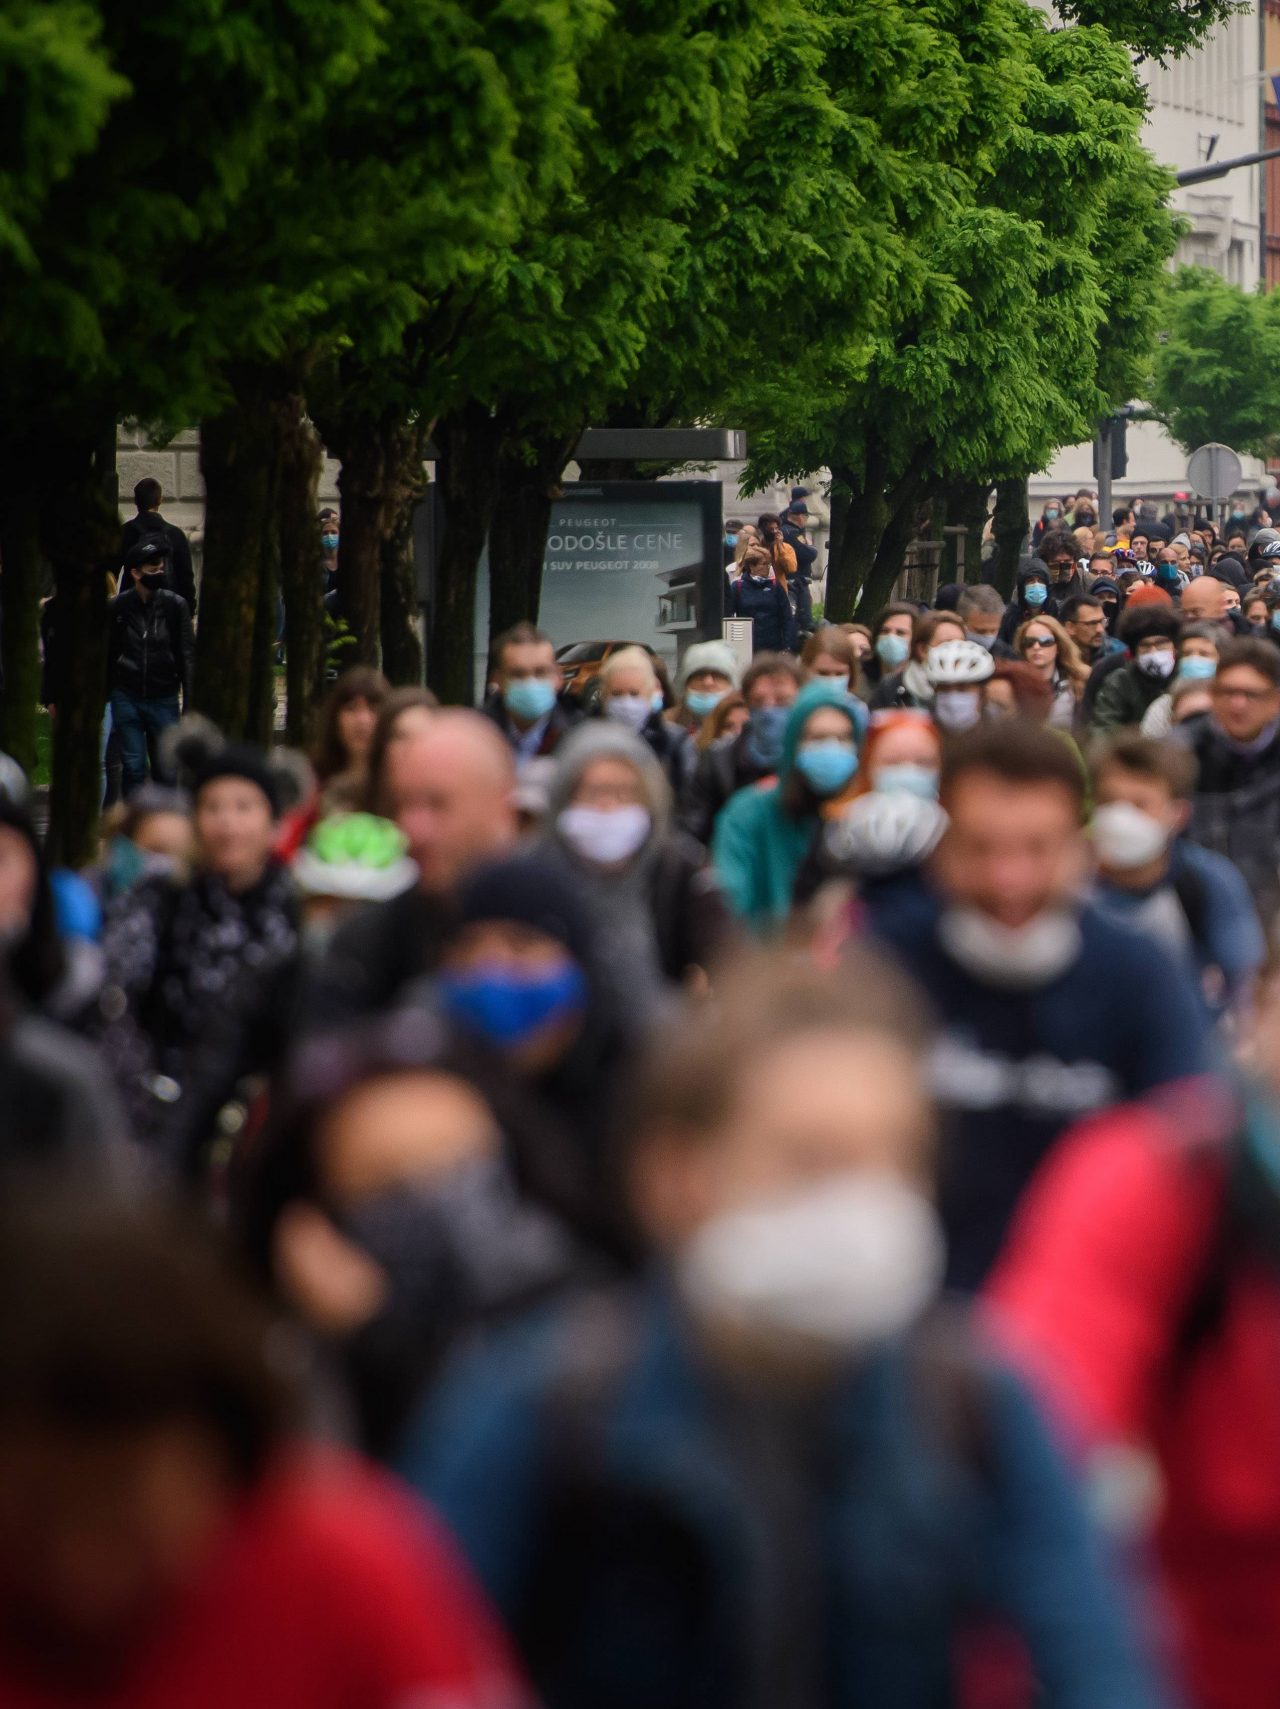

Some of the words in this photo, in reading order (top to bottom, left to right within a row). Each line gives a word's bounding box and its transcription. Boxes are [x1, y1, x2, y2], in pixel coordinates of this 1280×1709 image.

[559, 518, 617, 527] PEUGEOT
[548, 531, 628, 551] ODOŠLE
[633, 532, 683, 552] CENE
[550, 561, 573, 570] SUV
[576, 561, 630, 570] PEUGEOT
